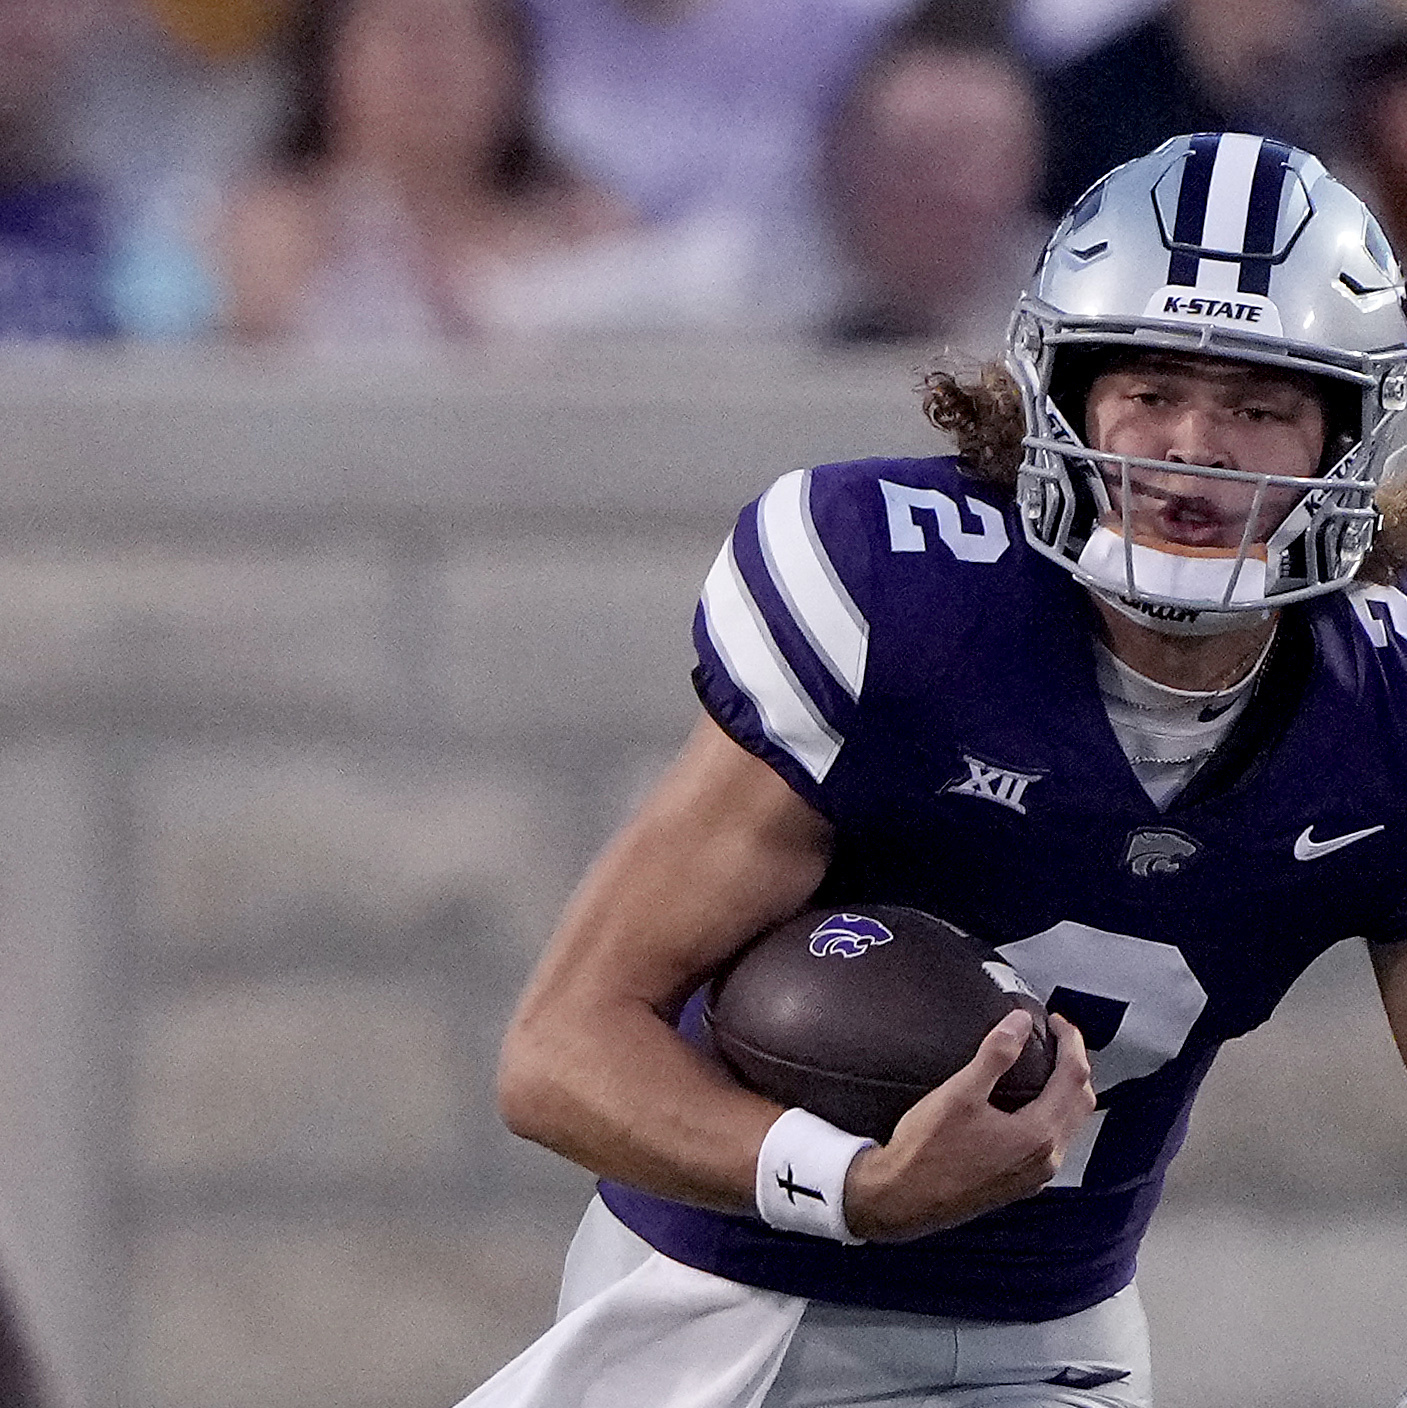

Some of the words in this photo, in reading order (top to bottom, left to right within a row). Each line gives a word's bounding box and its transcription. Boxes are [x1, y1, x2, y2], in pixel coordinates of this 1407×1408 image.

[1163, 296, 1263, 323] K-STATE
[878, 478, 1011, 563] 2
[947, 754, 1044, 815] XII
